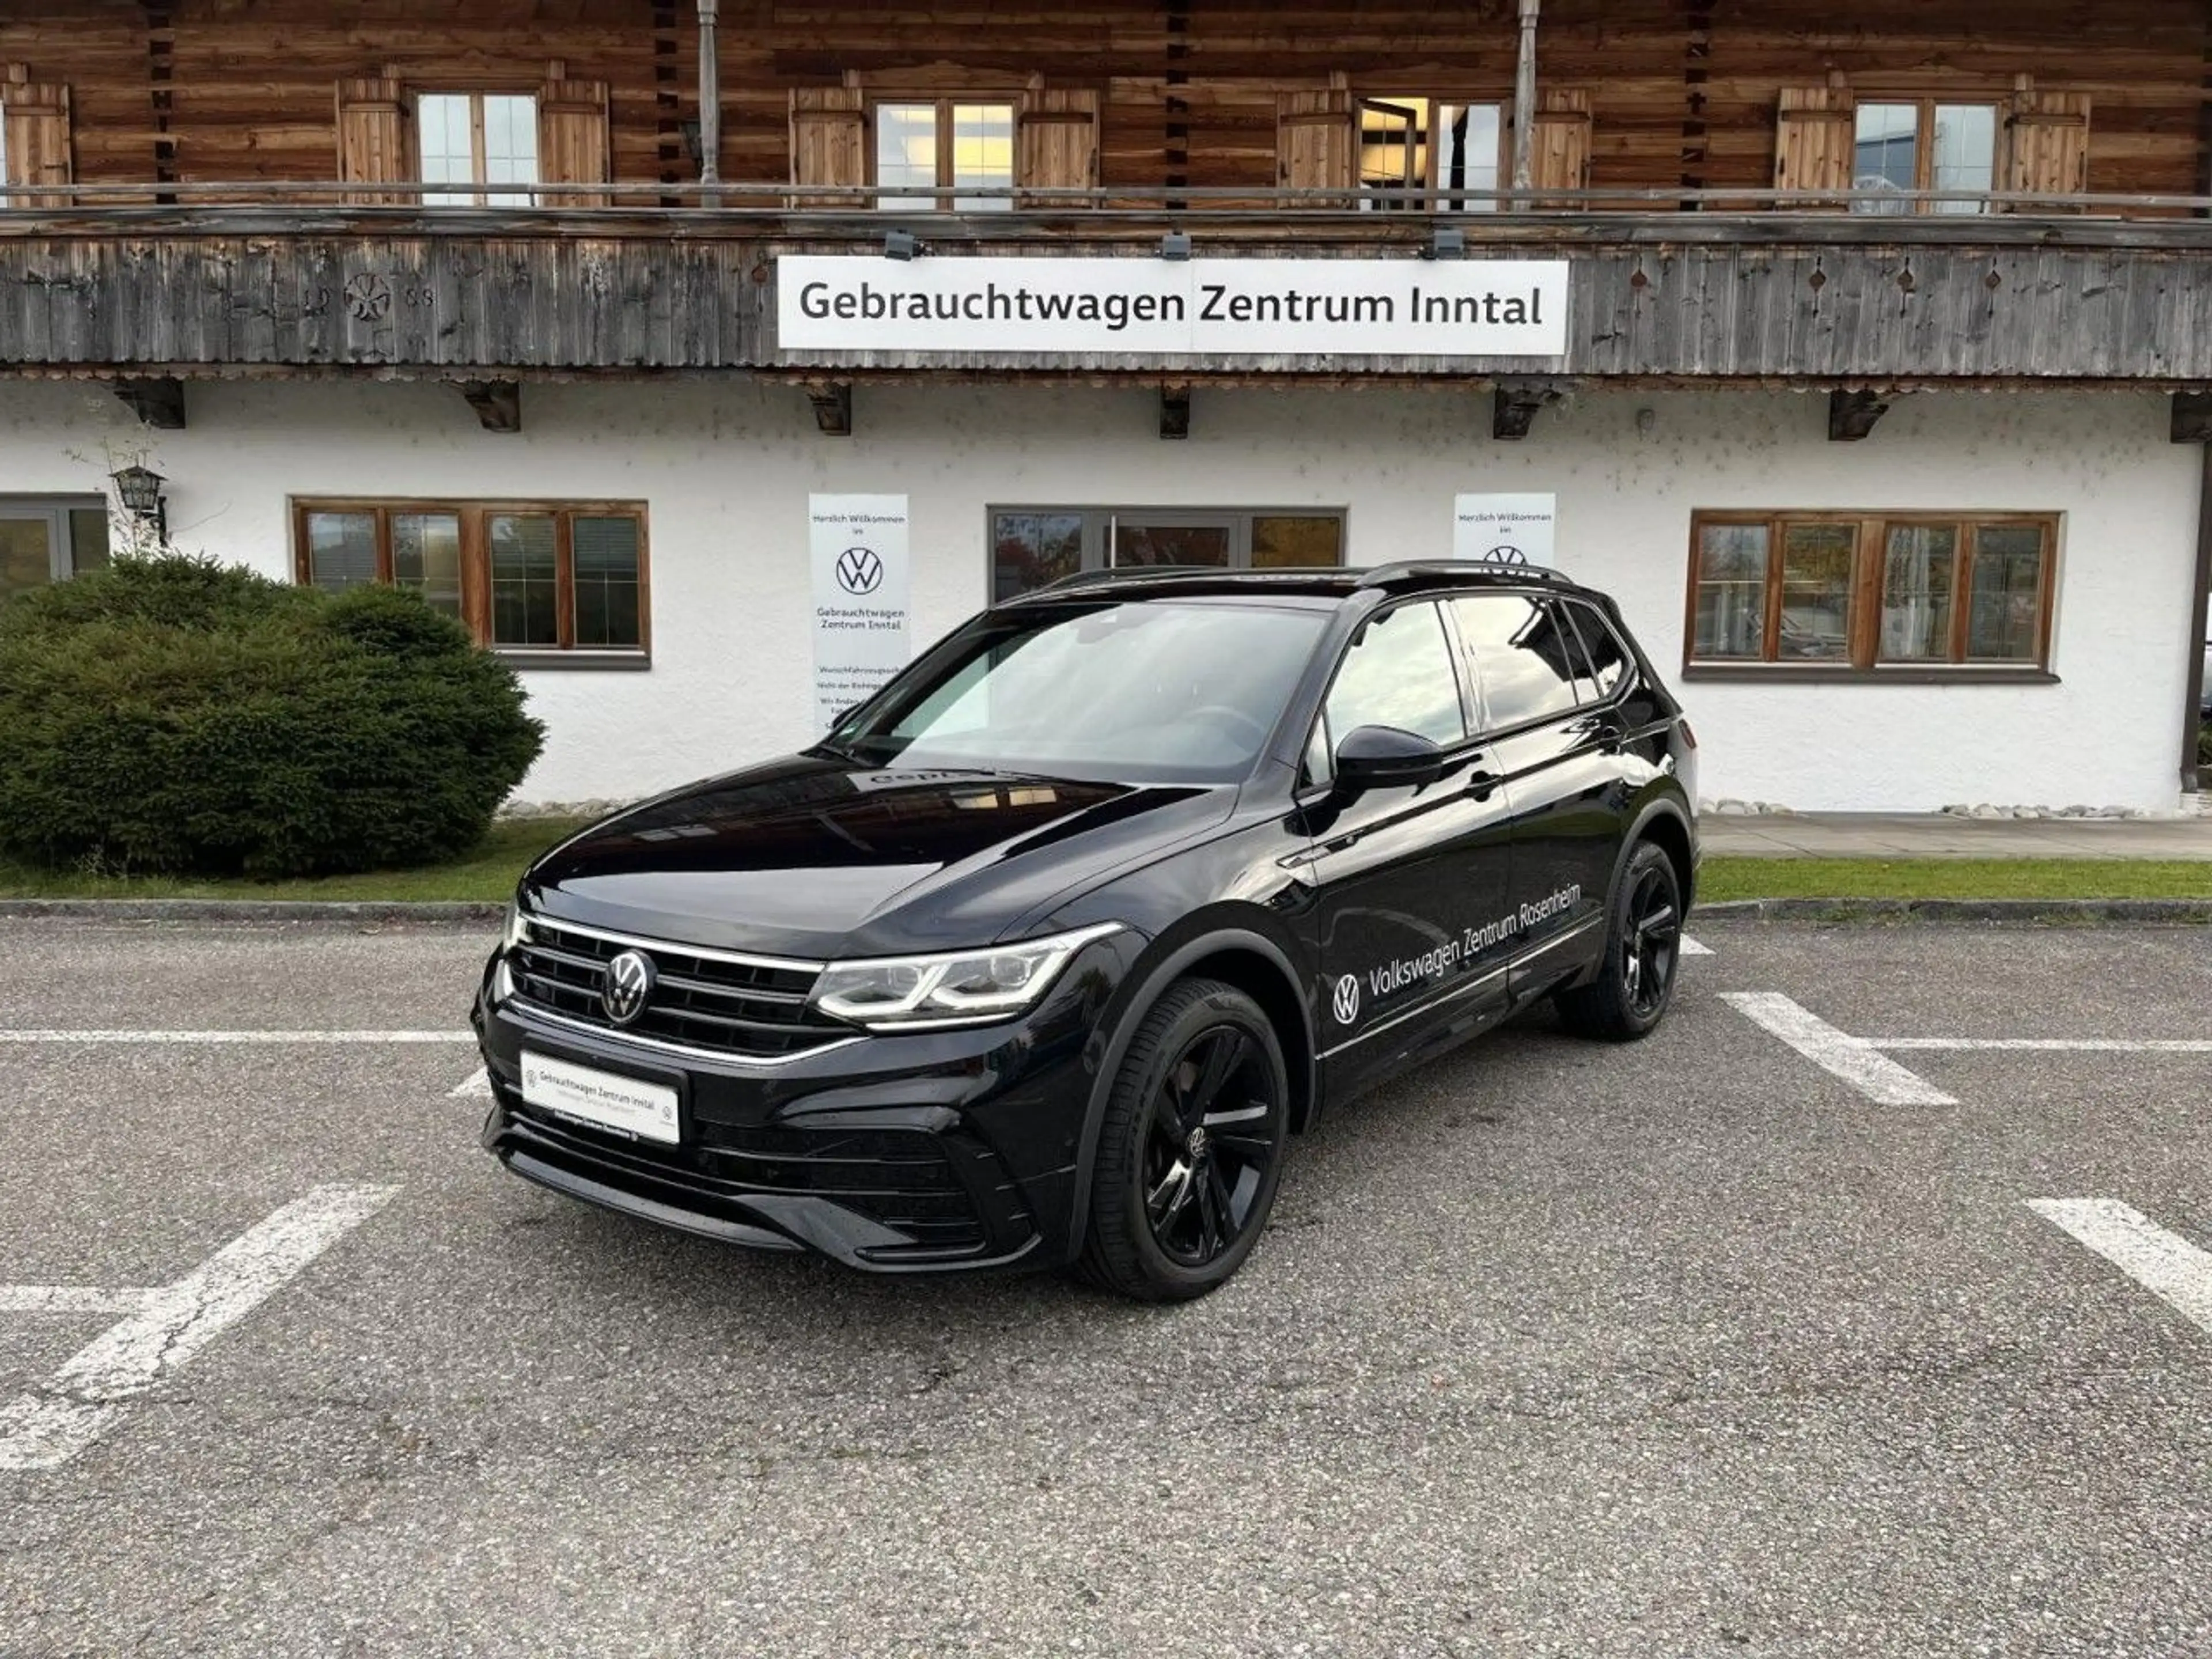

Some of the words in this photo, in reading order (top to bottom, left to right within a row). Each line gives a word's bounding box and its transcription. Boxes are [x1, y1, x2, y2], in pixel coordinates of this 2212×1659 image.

[801, 283, 1183, 330] Gebrauchtwagen
[1200, 286, 1393, 321] Zentrum
[1412, 287, 1541, 324] Inntal
[837, 548, 882, 594] VW
[817, 608, 904, 619] Gebrauchtwagen
[821, 620, 865, 628] Zentrum
[869, 621, 901, 629] Inntal
[1369, 941, 1460, 997] Volkswagen
[1463, 914, 1517, 956] Zentrum
[1519, 883, 1581, 928] Rosenheim
[1333, 974, 1359, 1024] VW
